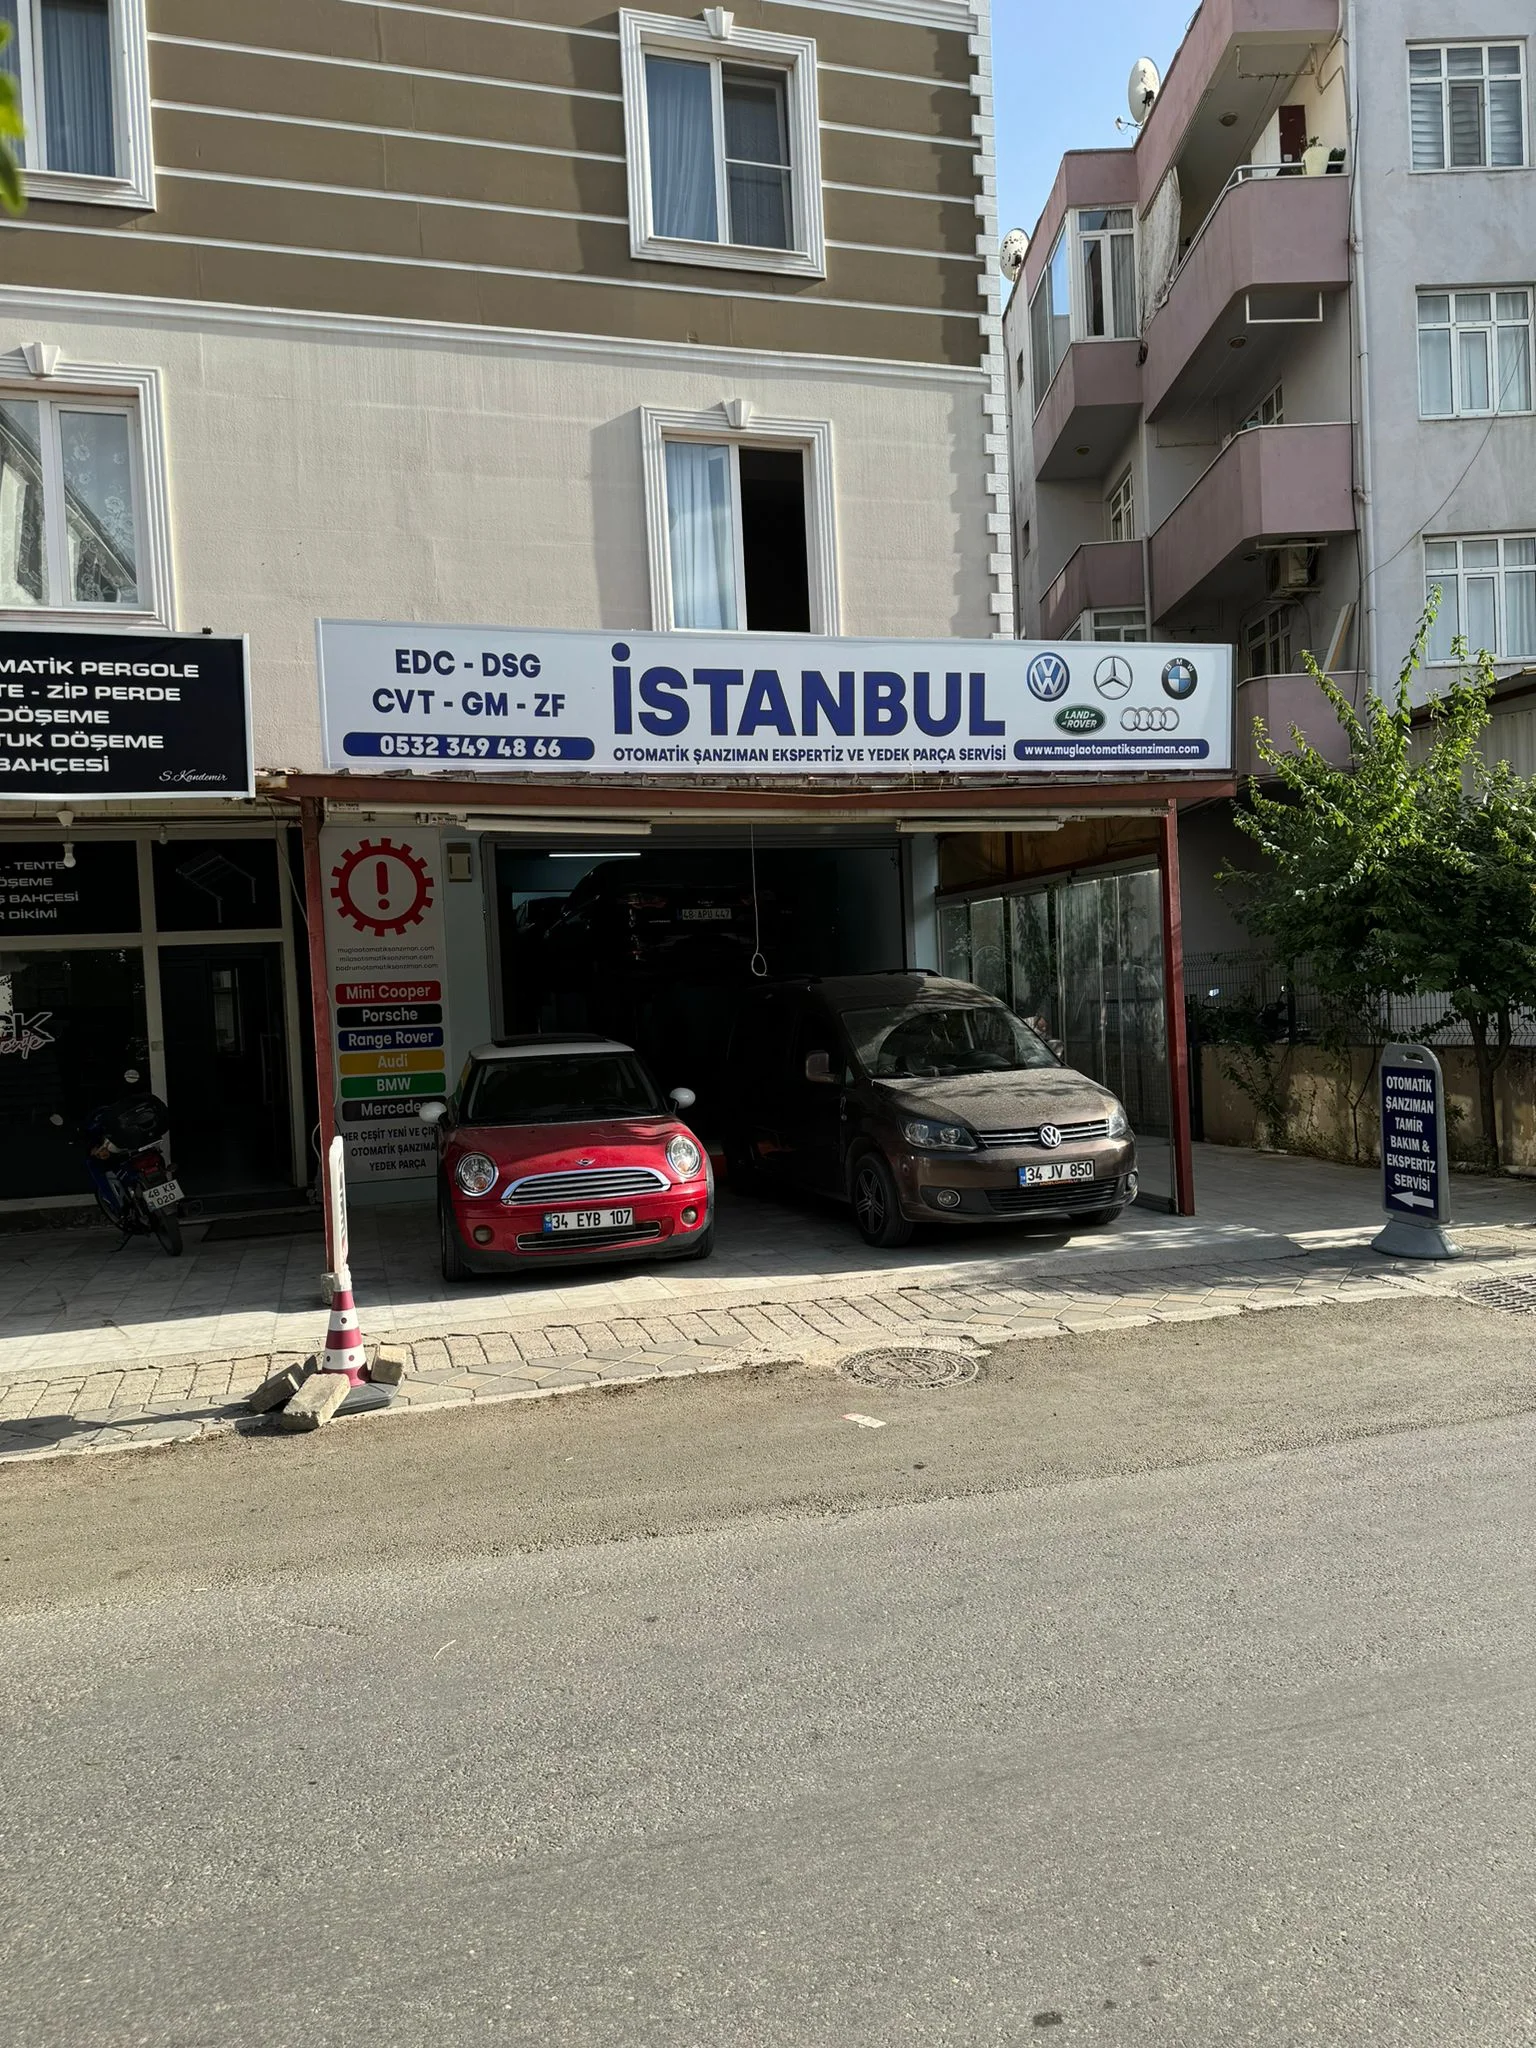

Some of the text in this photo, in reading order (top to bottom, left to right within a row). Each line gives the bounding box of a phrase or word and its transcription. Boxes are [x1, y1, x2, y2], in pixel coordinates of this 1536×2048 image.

[0, 657, 200, 678] MATİK PERGOLE
[395, 648, 456, 676] EDC
[481, 652, 541, 678] DSG
[46, 682, 88, 699] ZİP
[94, 686, 181, 701] PERDE
[611, 642, 1006, 738] İSTANBUL
[372, 688, 435, 714] CVT
[461, 691, 509, 716] GM
[534, 693, 566, 717] ZF
[1065, 710, 1089, 719] LAND
[1067, 719, 1097, 728] ROVER
[50, 731, 164, 751] DÖŞEME
[380, 735, 561, 758] 0532 349 48 66
[613, 744, 1006, 765] OTOMATİK ŞANZIMAN EKSPERTİZ VE YEDEK PARÇA SERVİSİ
[1024, 744, 1200, 756] www.muglaotomatiksanziman.com
[13, 860, 66, 871] TENTE
[9, 890, 79, 904] BAHÇESİ
[8, 908, 57, 920] DİKİMİ
[683, 909, 694, 919] 48
[346, 985, 431, 1000] Mini Cooper
[363, 1007, 418, 1022] Porsche
[348, 1031, 434, 1048] Range Rover
[378, 1054, 408, 1068] Audi
[377, 1078, 411, 1092] BMW
[1386, 1076, 1432, 1093] OTOMATİK
[361, 1099, 425, 1117] Mercede
[1385, 1096, 1434, 1114] ŞANZIMAN
[1395, 1116, 1423, 1133] TAMİR
[361, 1127, 385, 1142] ÇEŞİT
[387, 1126, 407, 1138] YENİ
[409, 1128, 421, 1136] VE
[351, 1142, 396, 1157] OTOMATİK
[1390, 1135, 1430, 1153] BAKIM &
[369, 1159, 426, 1171] YEDEK PARÇA
[1027, 1167, 1042, 1181] 34
[1048, 1165, 1063, 1179] JV
[1070, 1162, 1092, 1177] 850
[1386, 1153, 1436, 1173] EKSPERTİZ
[148, 1182, 176, 1198] 48 KB
[1394, 1173, 1430, 1192] SERVİSİ
[157, 1193, 175, 1205] 020
[552, 1210, 631, 1229] 34 EYB 107
